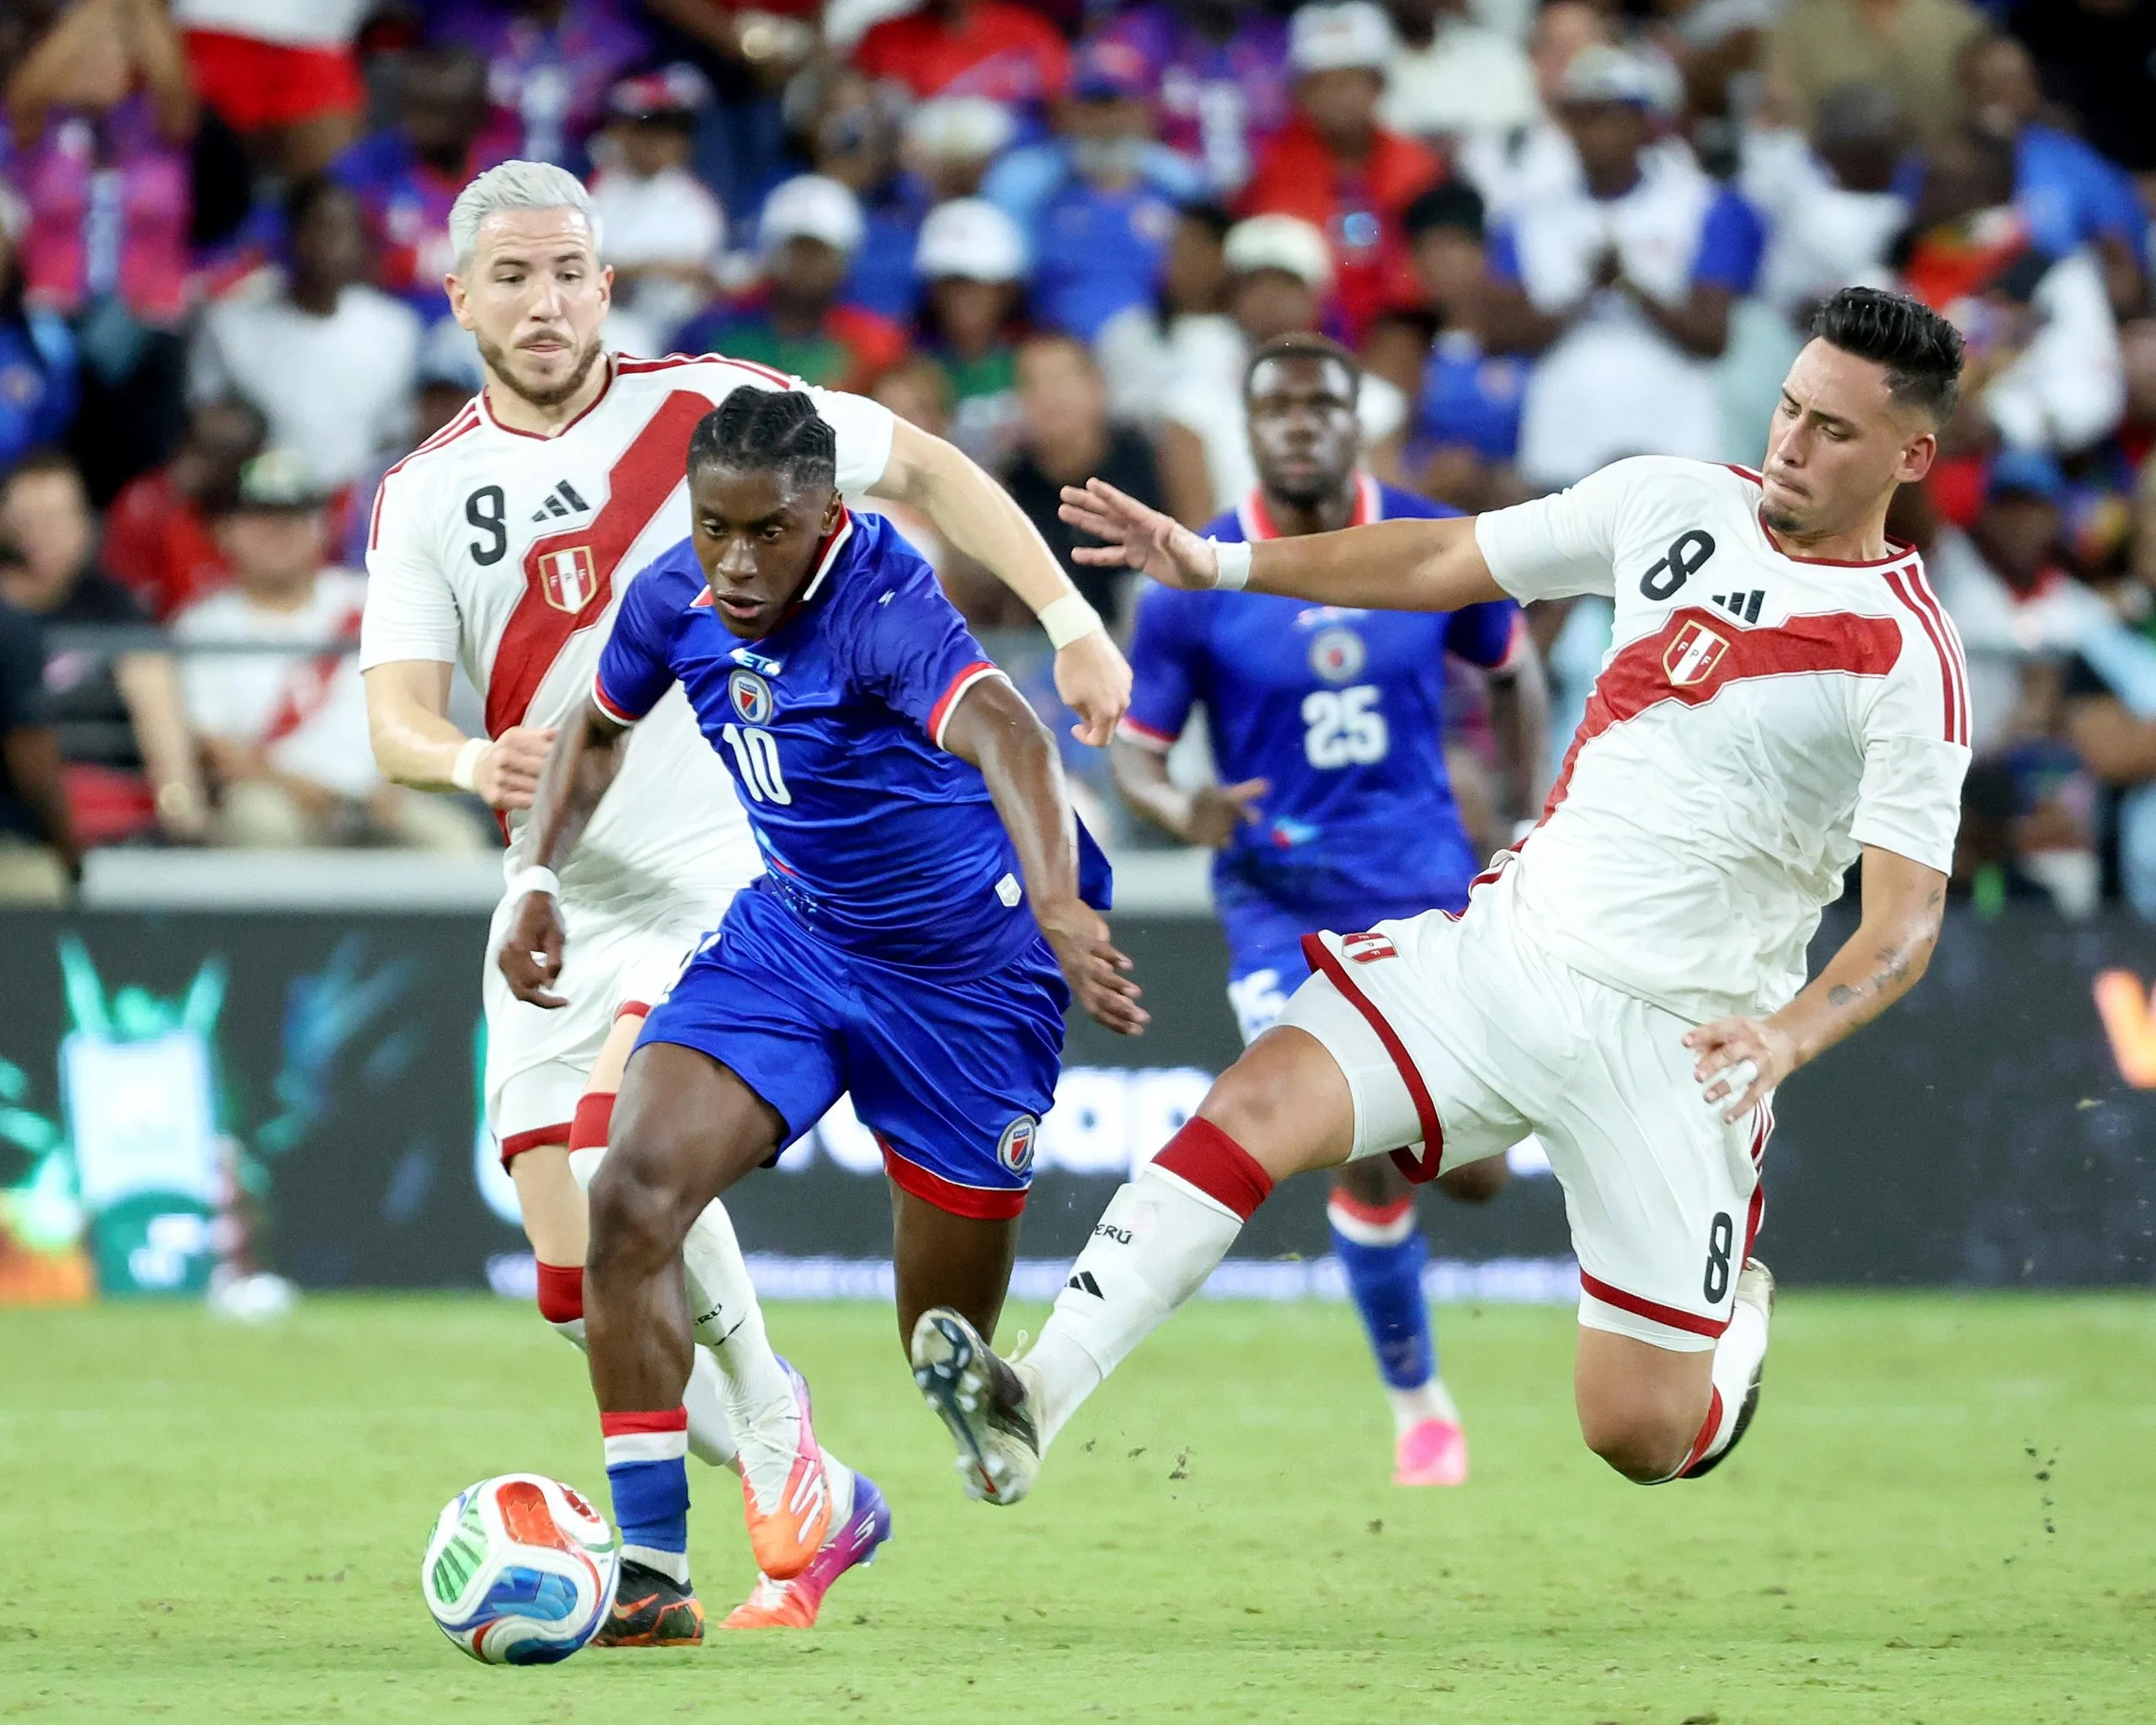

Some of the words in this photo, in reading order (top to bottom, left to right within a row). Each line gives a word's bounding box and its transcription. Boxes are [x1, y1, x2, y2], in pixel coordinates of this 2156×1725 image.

[466, 485, 507, 566] 9
[1641, 530, 1716, 601] 8
[723, 723, 792, 805] 10
[1302, 685, 1388, 769] 25
[1095, 1224, 1133, 1245] ERÚ
[1704, 1212, 1732, 1304] 8
